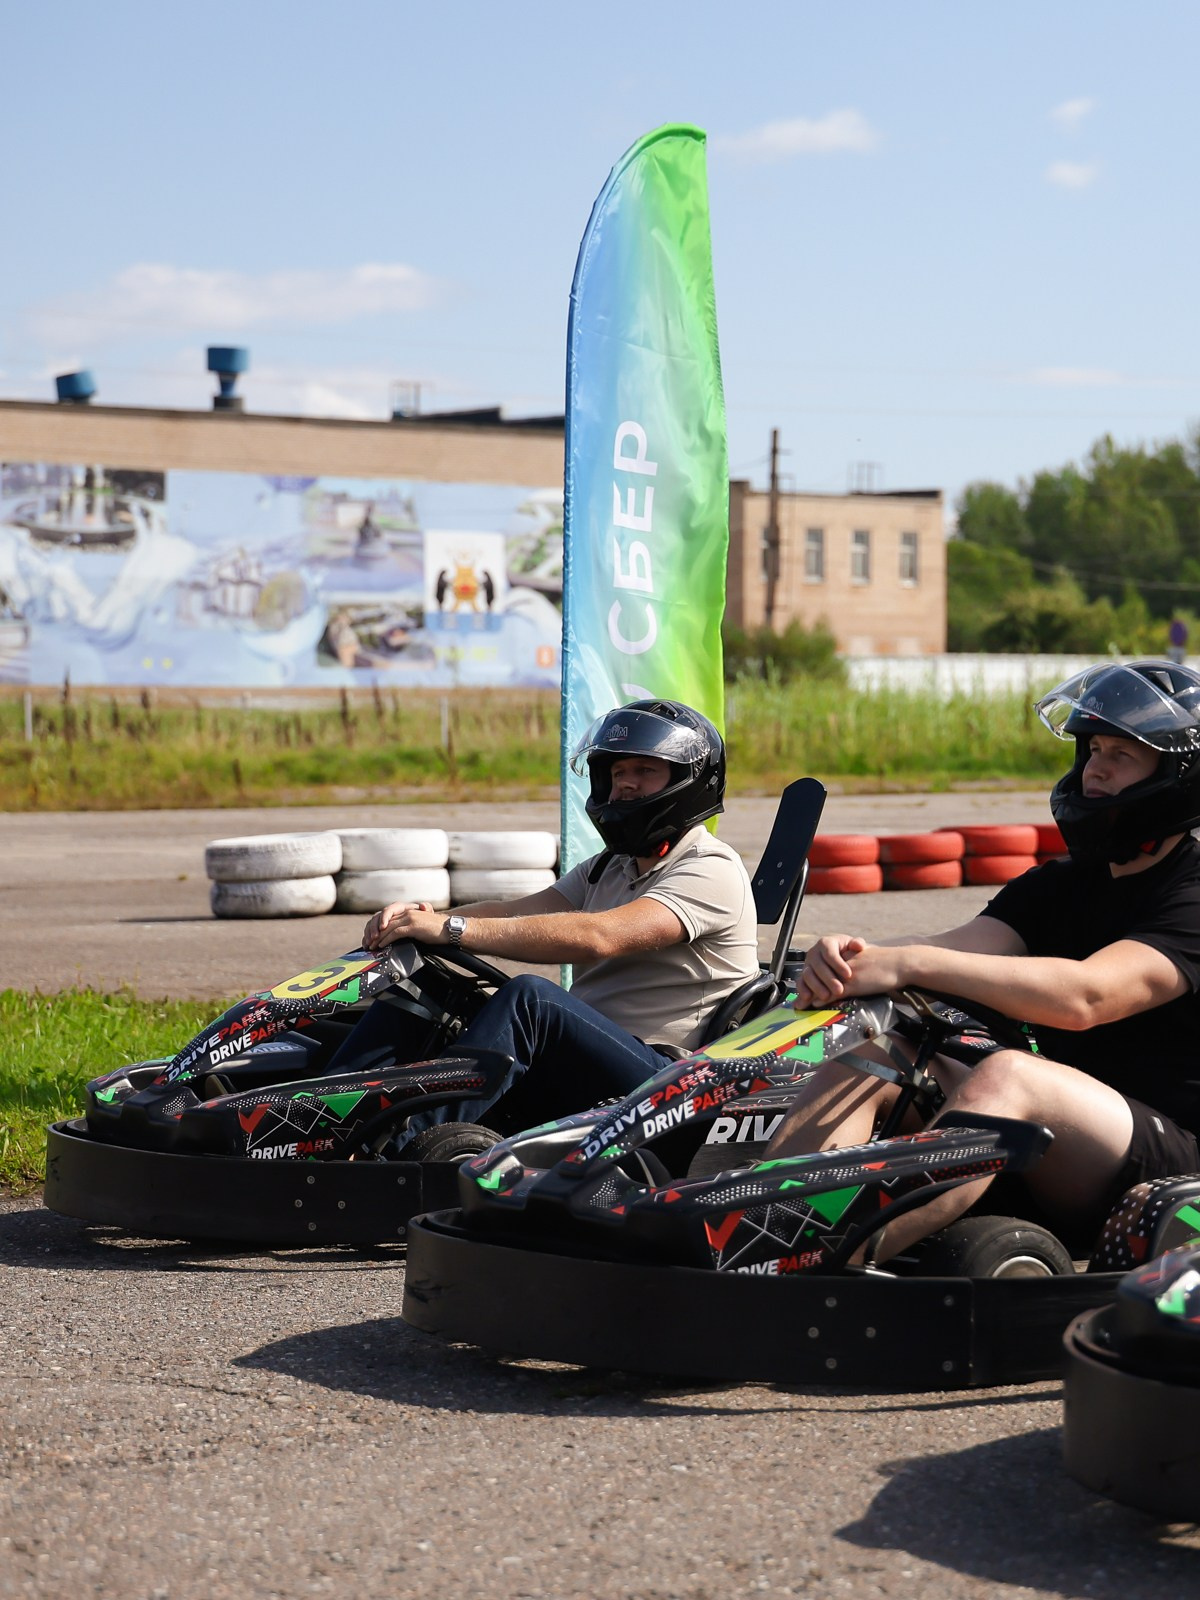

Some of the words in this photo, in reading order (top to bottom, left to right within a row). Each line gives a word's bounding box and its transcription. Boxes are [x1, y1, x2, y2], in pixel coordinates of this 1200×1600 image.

[608, 420, 658, 655] СБЕР
[287, 966, 347, 992] 3
[168, 1006, 272, 1082] DRIVEPARK
[209, 1019, 288, 1065] DRIVEPARK
[734, 1018, 800, 1051] 1
[584, 1063, 717, 1160] DRIVEPARK
[643, 1080, 740, 1139] DRIVEPARK
